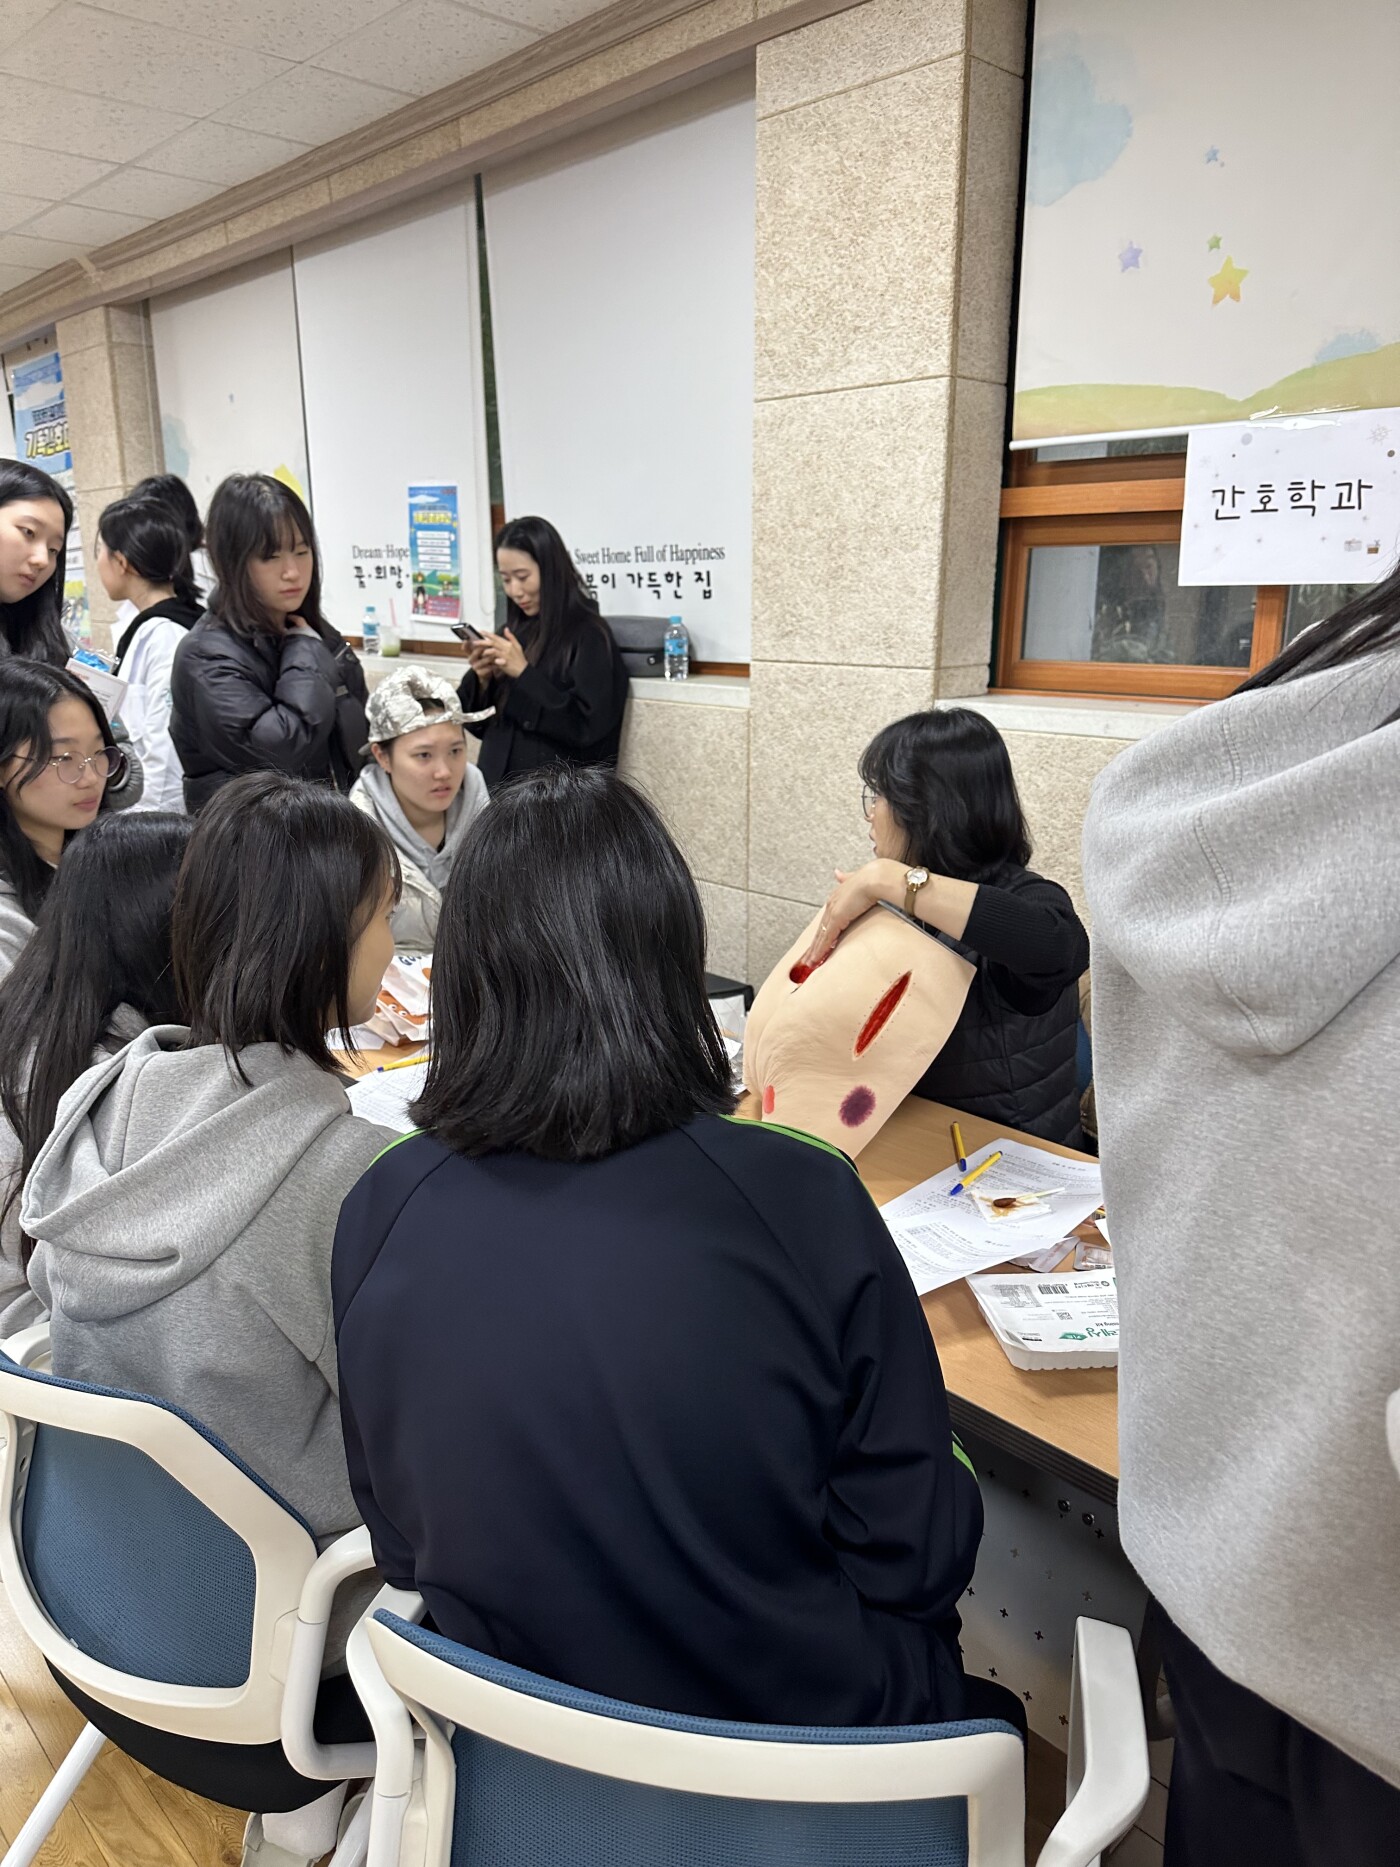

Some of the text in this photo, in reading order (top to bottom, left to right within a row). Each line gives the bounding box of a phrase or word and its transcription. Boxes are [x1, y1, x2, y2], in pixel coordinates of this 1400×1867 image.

[1211, 479, 1374, 521] 간호학과
[574, 543, 725, 565] Sweet Home Full of Happiness
[626, 571, 682, 600] 가득한
[693, 570, 713, 600] 집
[1085, 1327, 1119, 1338] 레싱
